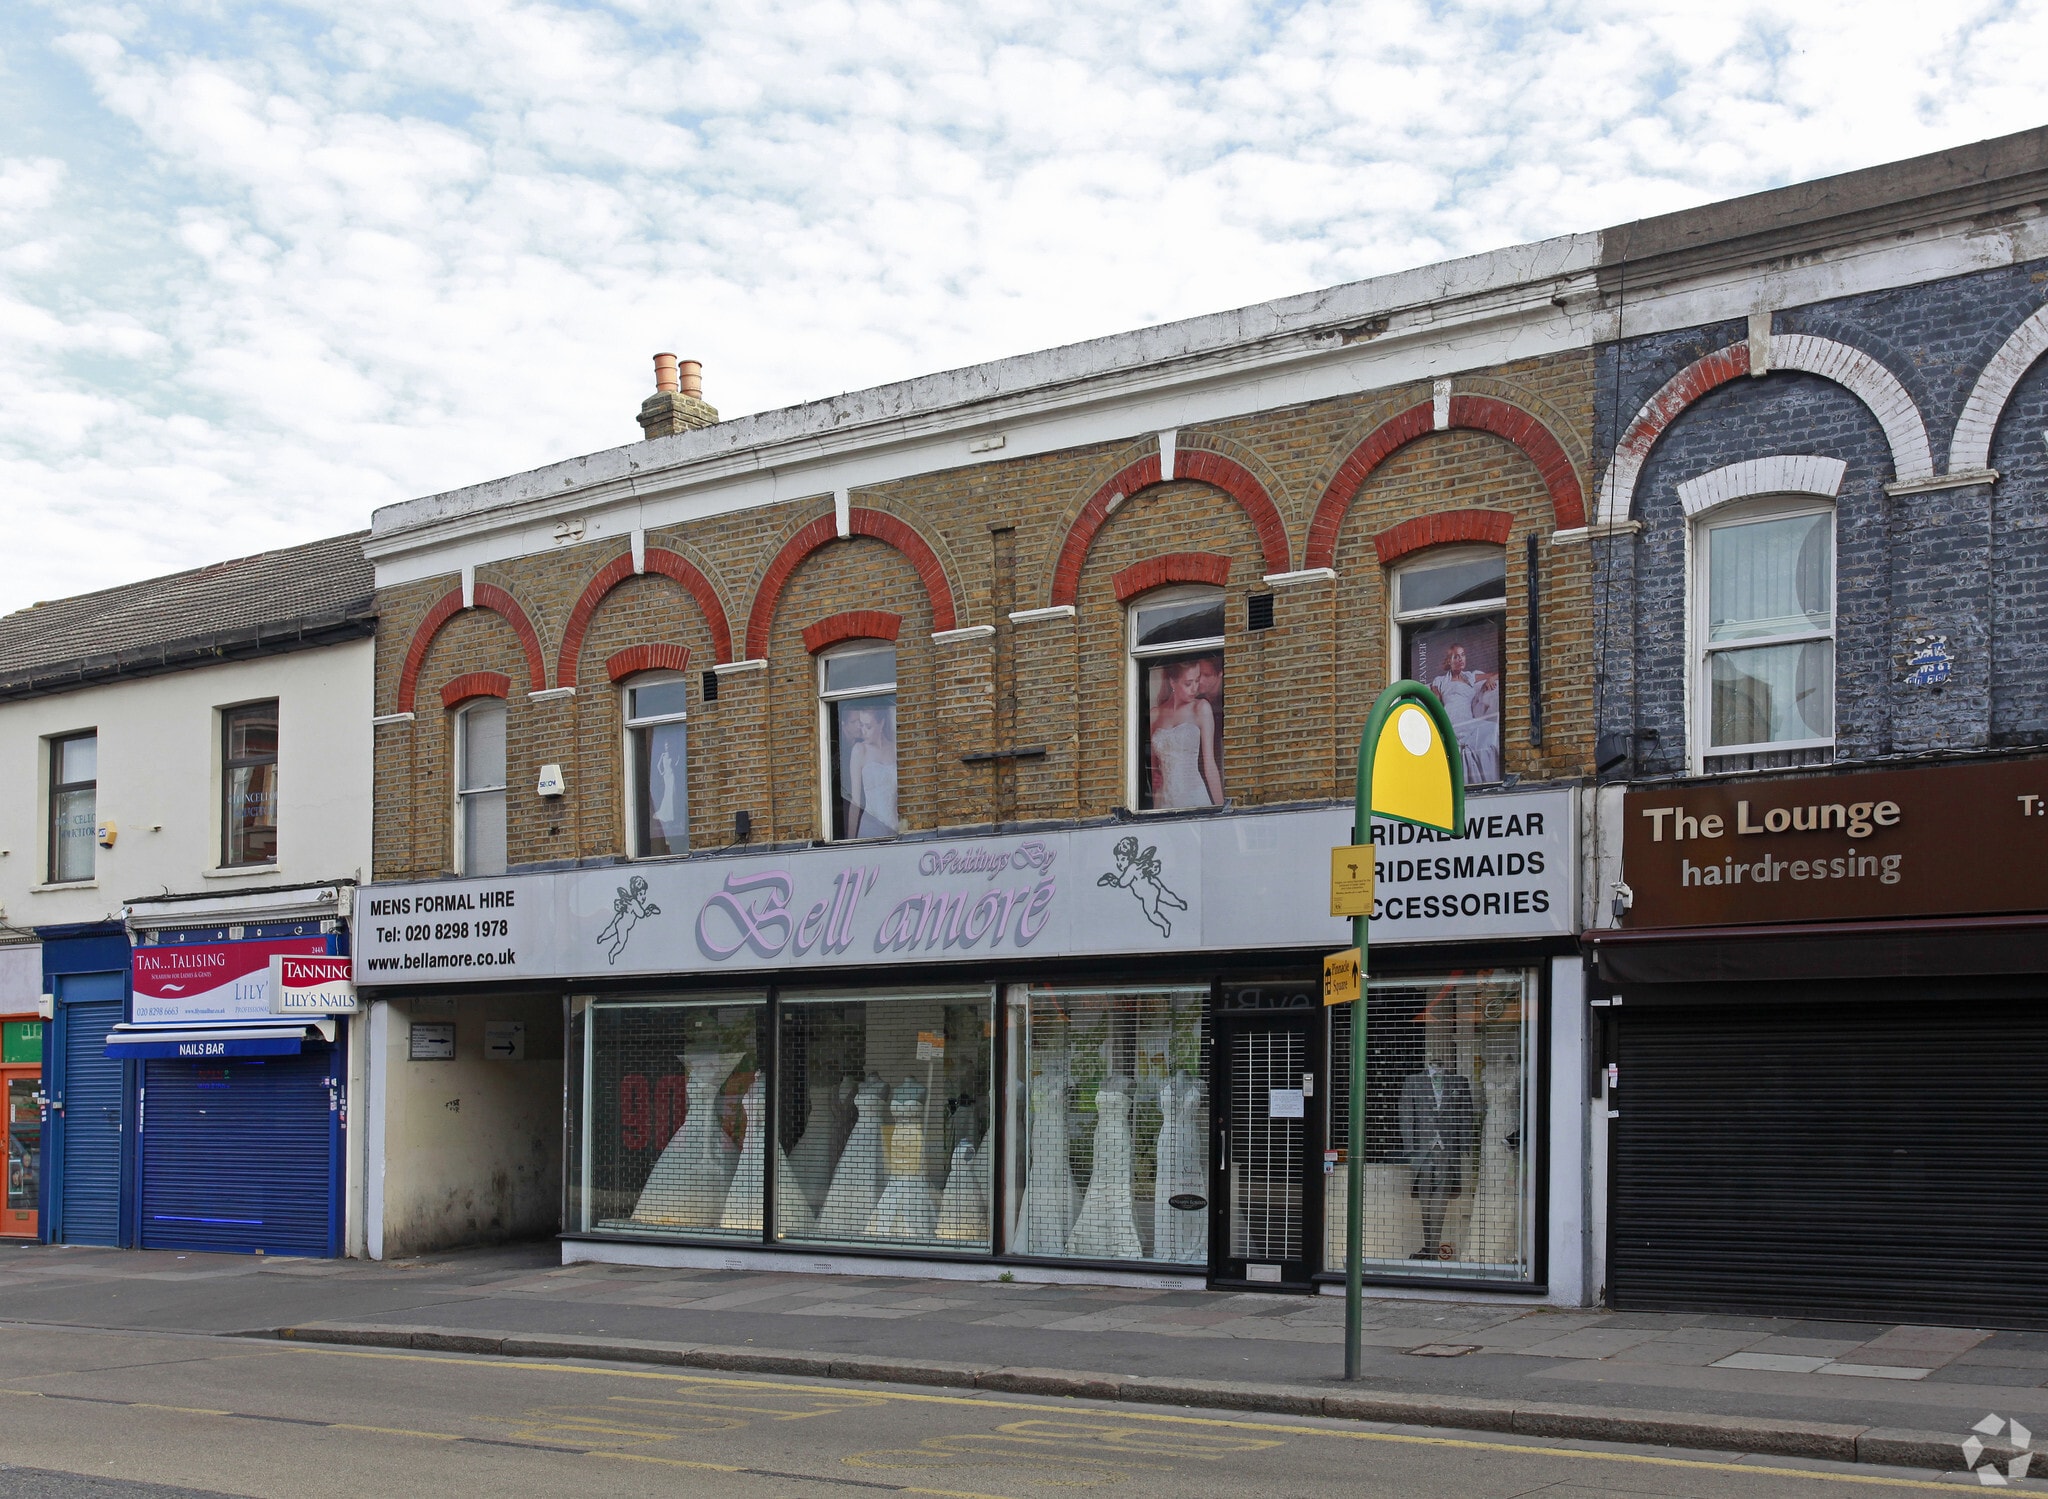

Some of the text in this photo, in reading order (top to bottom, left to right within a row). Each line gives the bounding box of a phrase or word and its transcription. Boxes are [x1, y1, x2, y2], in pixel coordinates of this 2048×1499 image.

[1418, 643, 1427, 685] EXANDER
[1351, 812, 1544, 846] RIDAL WEAR
[1642, 798, 1901, 842] The Lounge
[918, 839, 1058, 882] Weddings By
[1375, 851, 1545, 884] RIDESMAIDS
[1682, 847, 1902, 887] hairdressing
[370, 890, 515, 917] MENS FORMAL HIRE
[1346, 889, 1550, 922] CCESSORIES
[376, 919, 508, 944] Tel: 020 8298 1978
[367, 948, 516, 971] www.bellamore.co.uk
[1332, 960, 1350, 976] Pinnacle
[235, 981, 269, 1001] LILY'
[284, 991, 355, 1008] LILY'S NAILS
[1333, 980, 1348, 996] Square
[136, 1007, 148, 1017] 020
[148, 1007, 164, 1017] 8298
[164, 1006, 179, 1016] 6663
[179, 1043, 225, 1056] NAILS BAR
